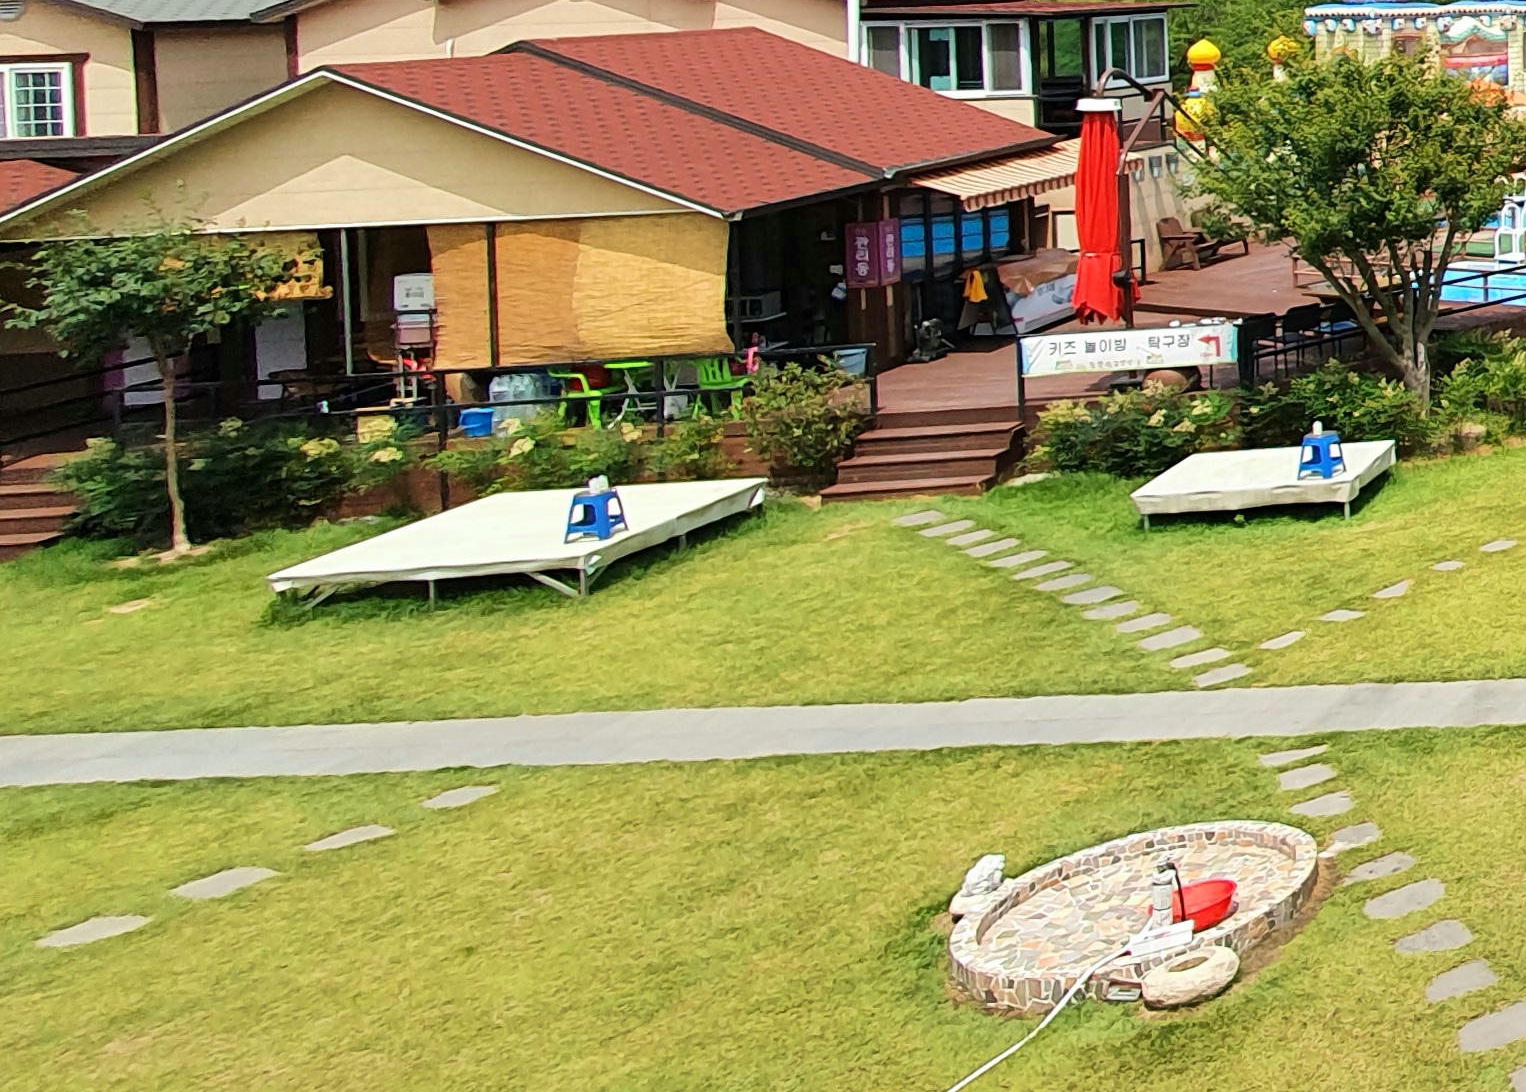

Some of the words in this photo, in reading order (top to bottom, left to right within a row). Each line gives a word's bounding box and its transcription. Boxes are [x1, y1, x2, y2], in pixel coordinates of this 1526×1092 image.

[1049, 340, 1077, 356] 키즈
[1084, 338, 1127, 354] 놀이방
[1148, 334, 1190, 349] 탁구장
